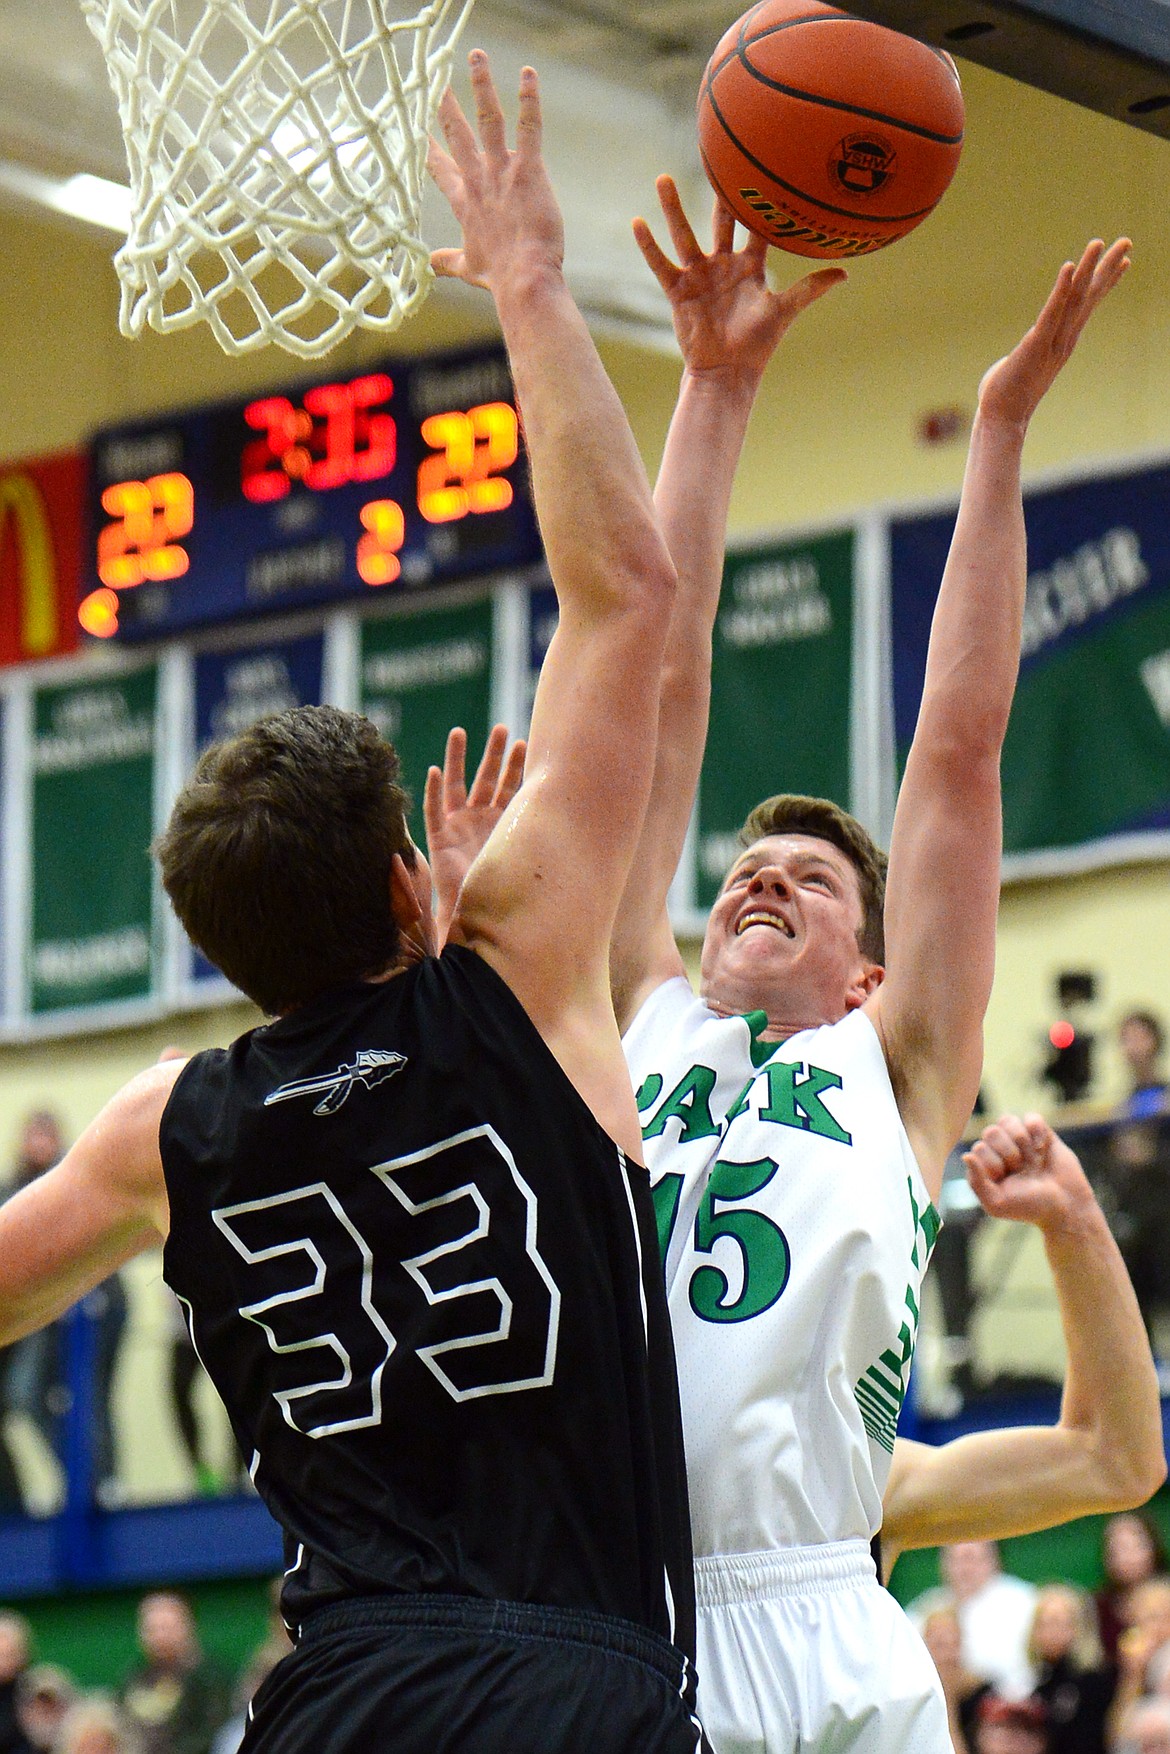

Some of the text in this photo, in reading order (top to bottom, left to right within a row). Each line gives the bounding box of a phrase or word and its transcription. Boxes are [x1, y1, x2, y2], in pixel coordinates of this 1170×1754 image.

[417, 402, 518, 523] 22
[98, 472, 194, 589] 22
[211, 1123, 562, 1440] 33
